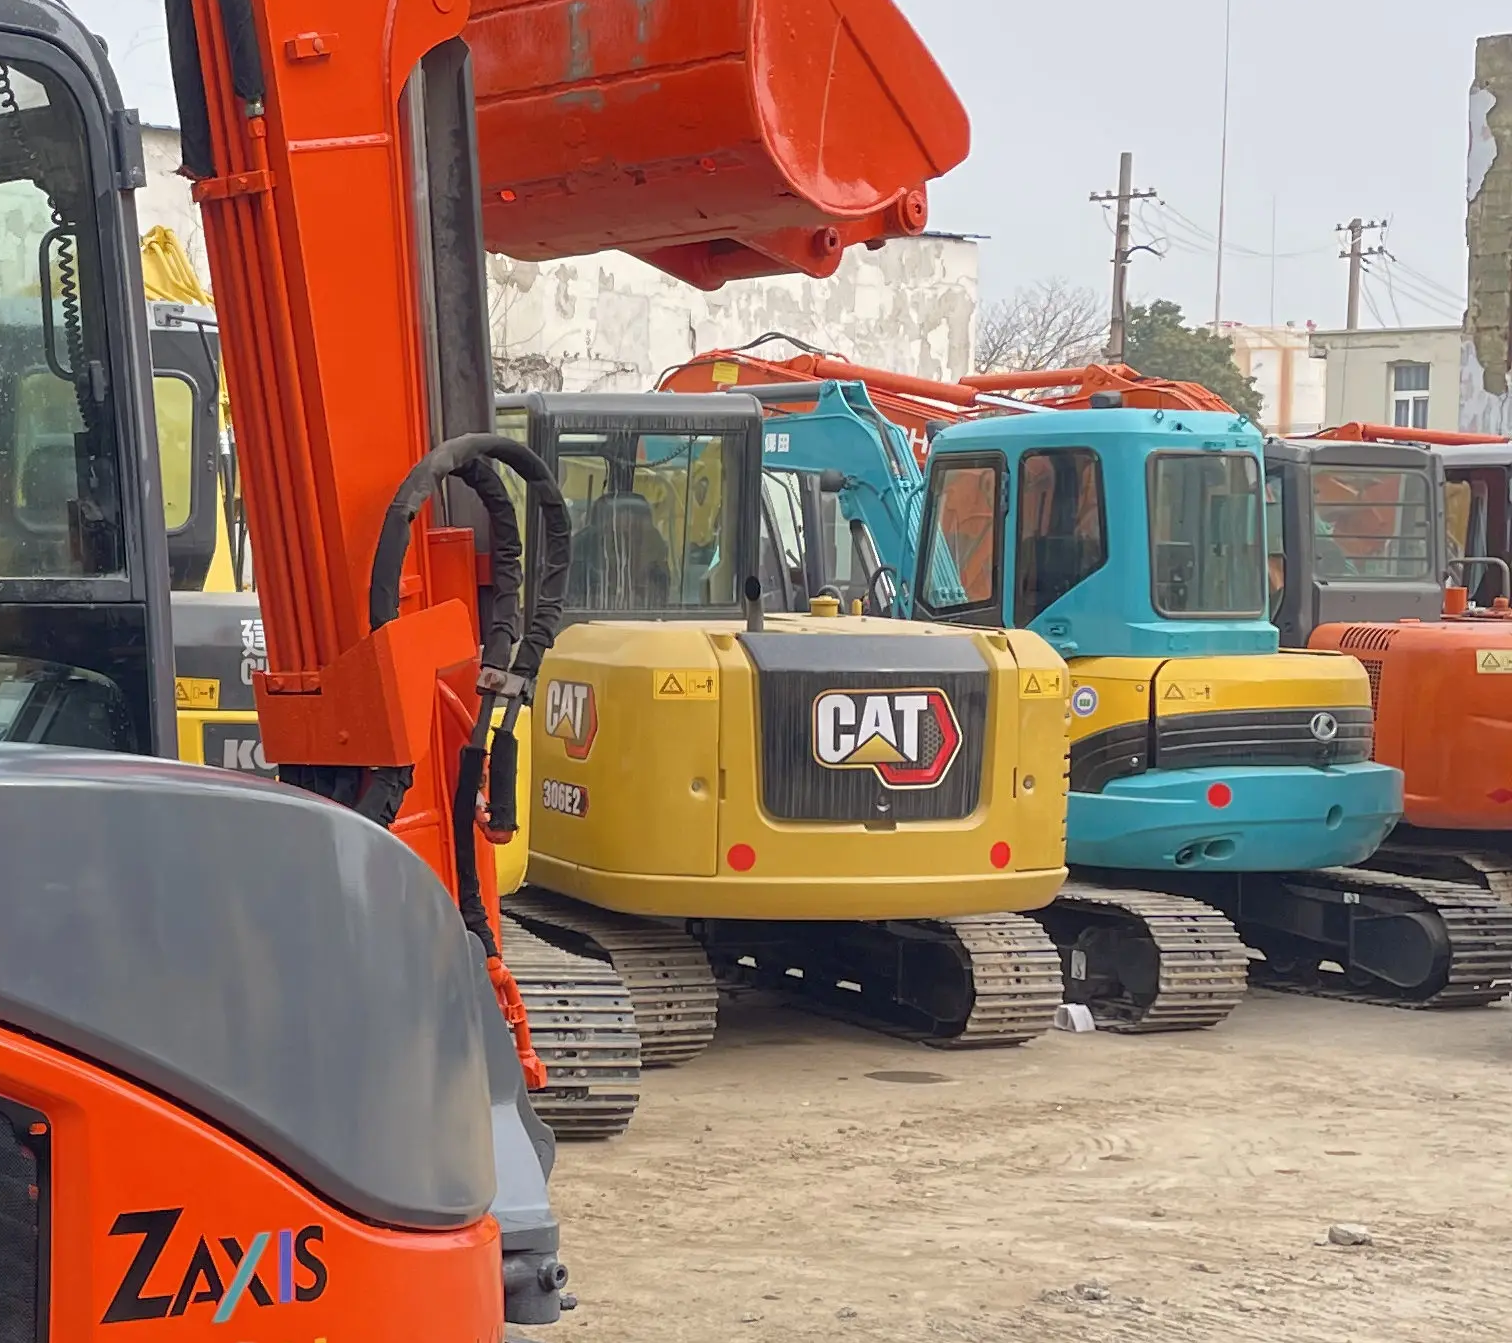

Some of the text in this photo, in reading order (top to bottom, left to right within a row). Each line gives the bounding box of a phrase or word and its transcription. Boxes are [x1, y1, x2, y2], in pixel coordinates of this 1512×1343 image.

[546, 680, 588, 739] CAT
[817, 694, 928, 763] CAT
[542, 779, 581, 816] 306E2
[99, 1207, 329, 1325] ZAXIS
